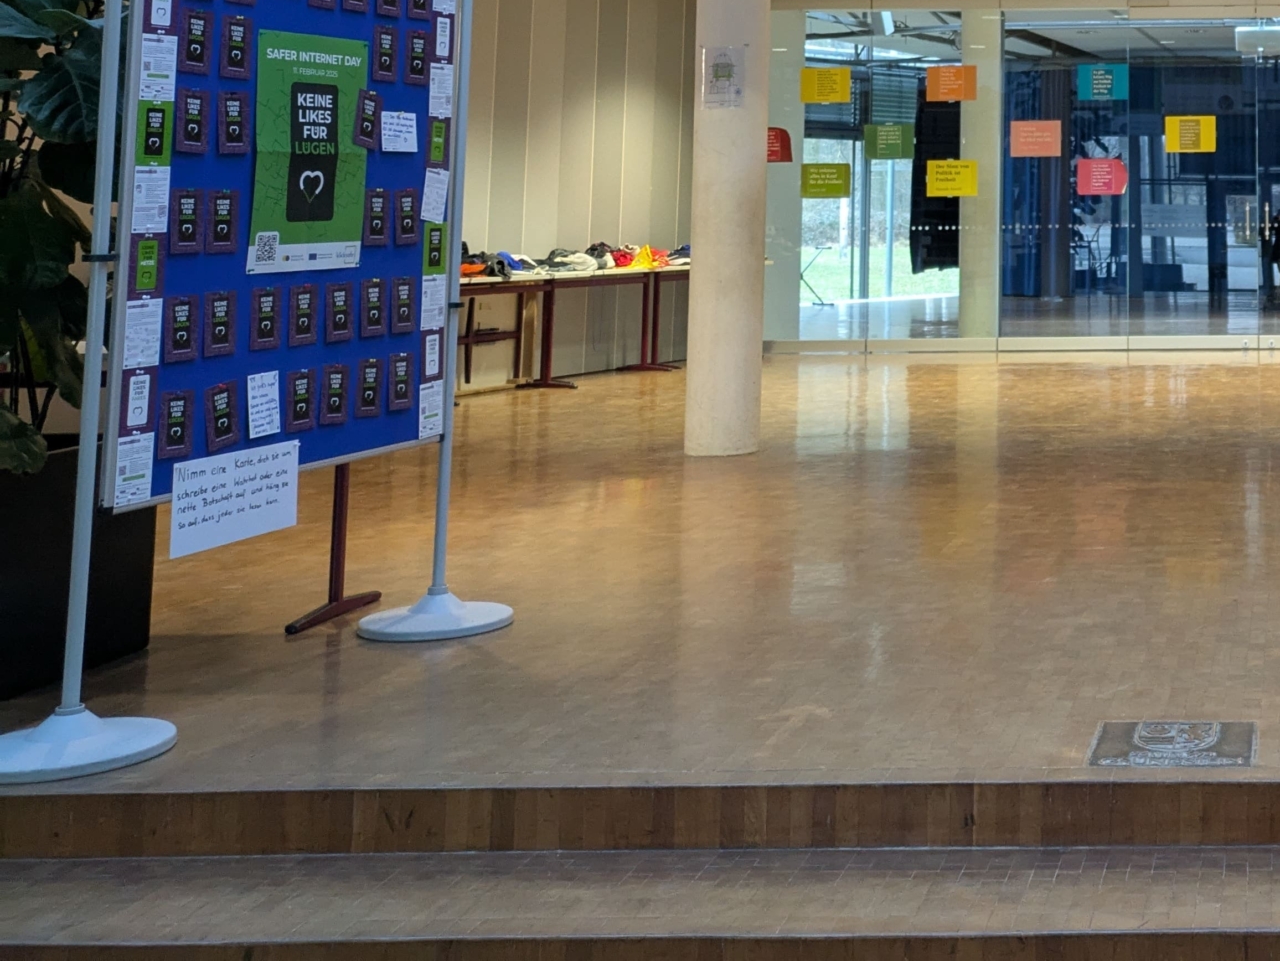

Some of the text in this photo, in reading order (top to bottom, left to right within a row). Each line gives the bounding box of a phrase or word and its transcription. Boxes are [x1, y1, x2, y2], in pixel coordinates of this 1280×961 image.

[267, 48, 361, 66] SAFER INTERNET DAY
[297, 93, 333, 107] KEINE
[299, 109, 331, 124] LIKES
[304, 126, 327, 139] FÜR
[295, 141, 334, 155] LÜGEN
[178, 467, 206, 482] Nimm
[211, 466, 226, 475] eine
[177, 485, 207, 501] schreibe
[212, 482, 226, 493] eine
[260, 472, 273, 480] oder
[276, 469, 287, 477] eine
[177, 502, 196, 514] nette
[202, 491, 233, 507] Botschaft
[236, 489, 246, 499] auf
[251, 484, 263, 495] und
[201, 515, 214, 523] dass
[216, 510, 233, 523] jeder
